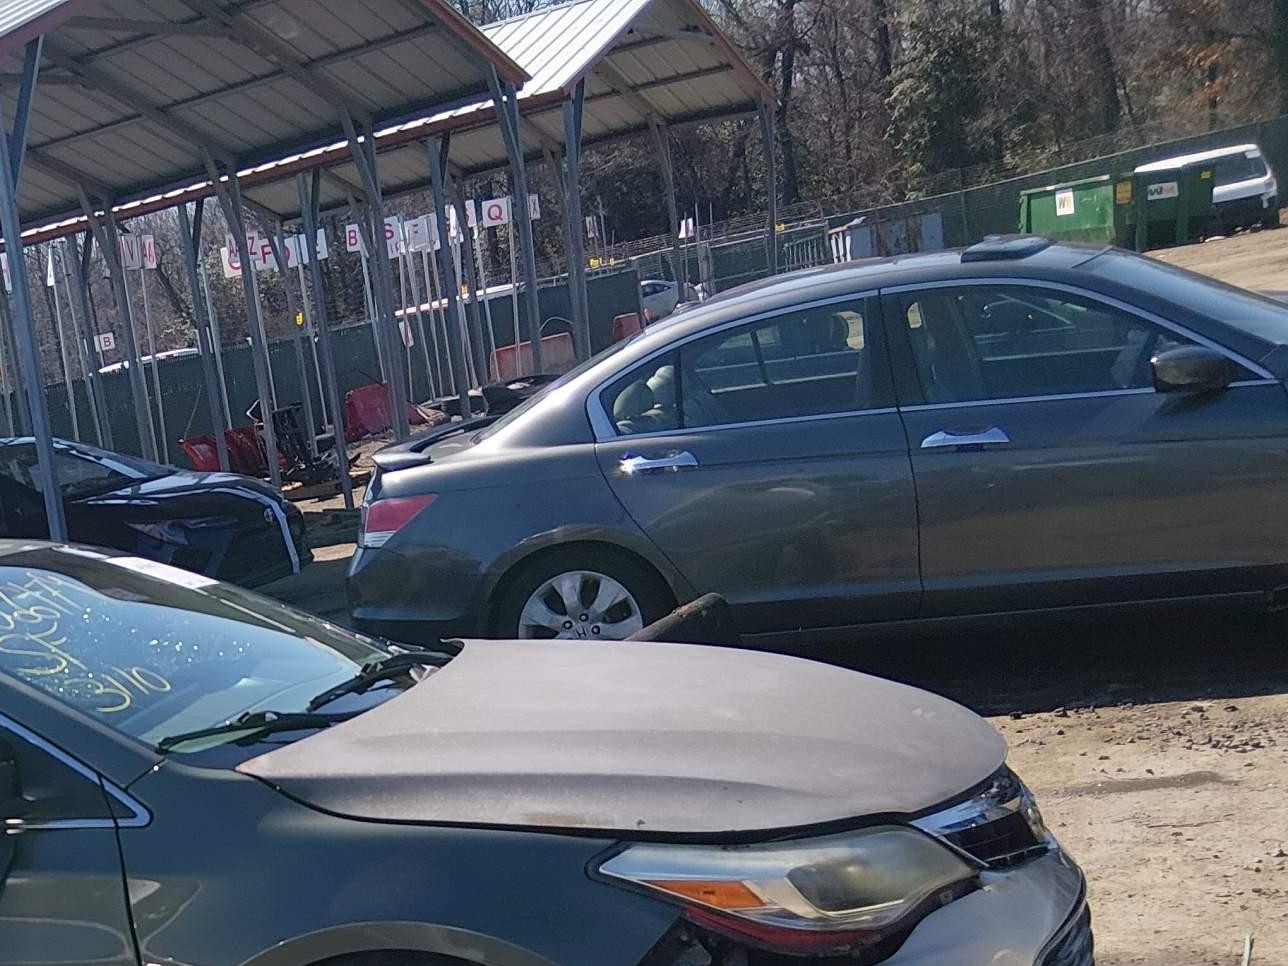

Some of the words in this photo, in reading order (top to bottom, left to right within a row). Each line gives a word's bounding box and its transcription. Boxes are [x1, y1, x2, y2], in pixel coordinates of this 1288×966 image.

[487, 204, 503, 221] Q
[247, 236, 257, 256] Z
[348, 229, 358, 247] B
[102, 336, 112, 348] B
